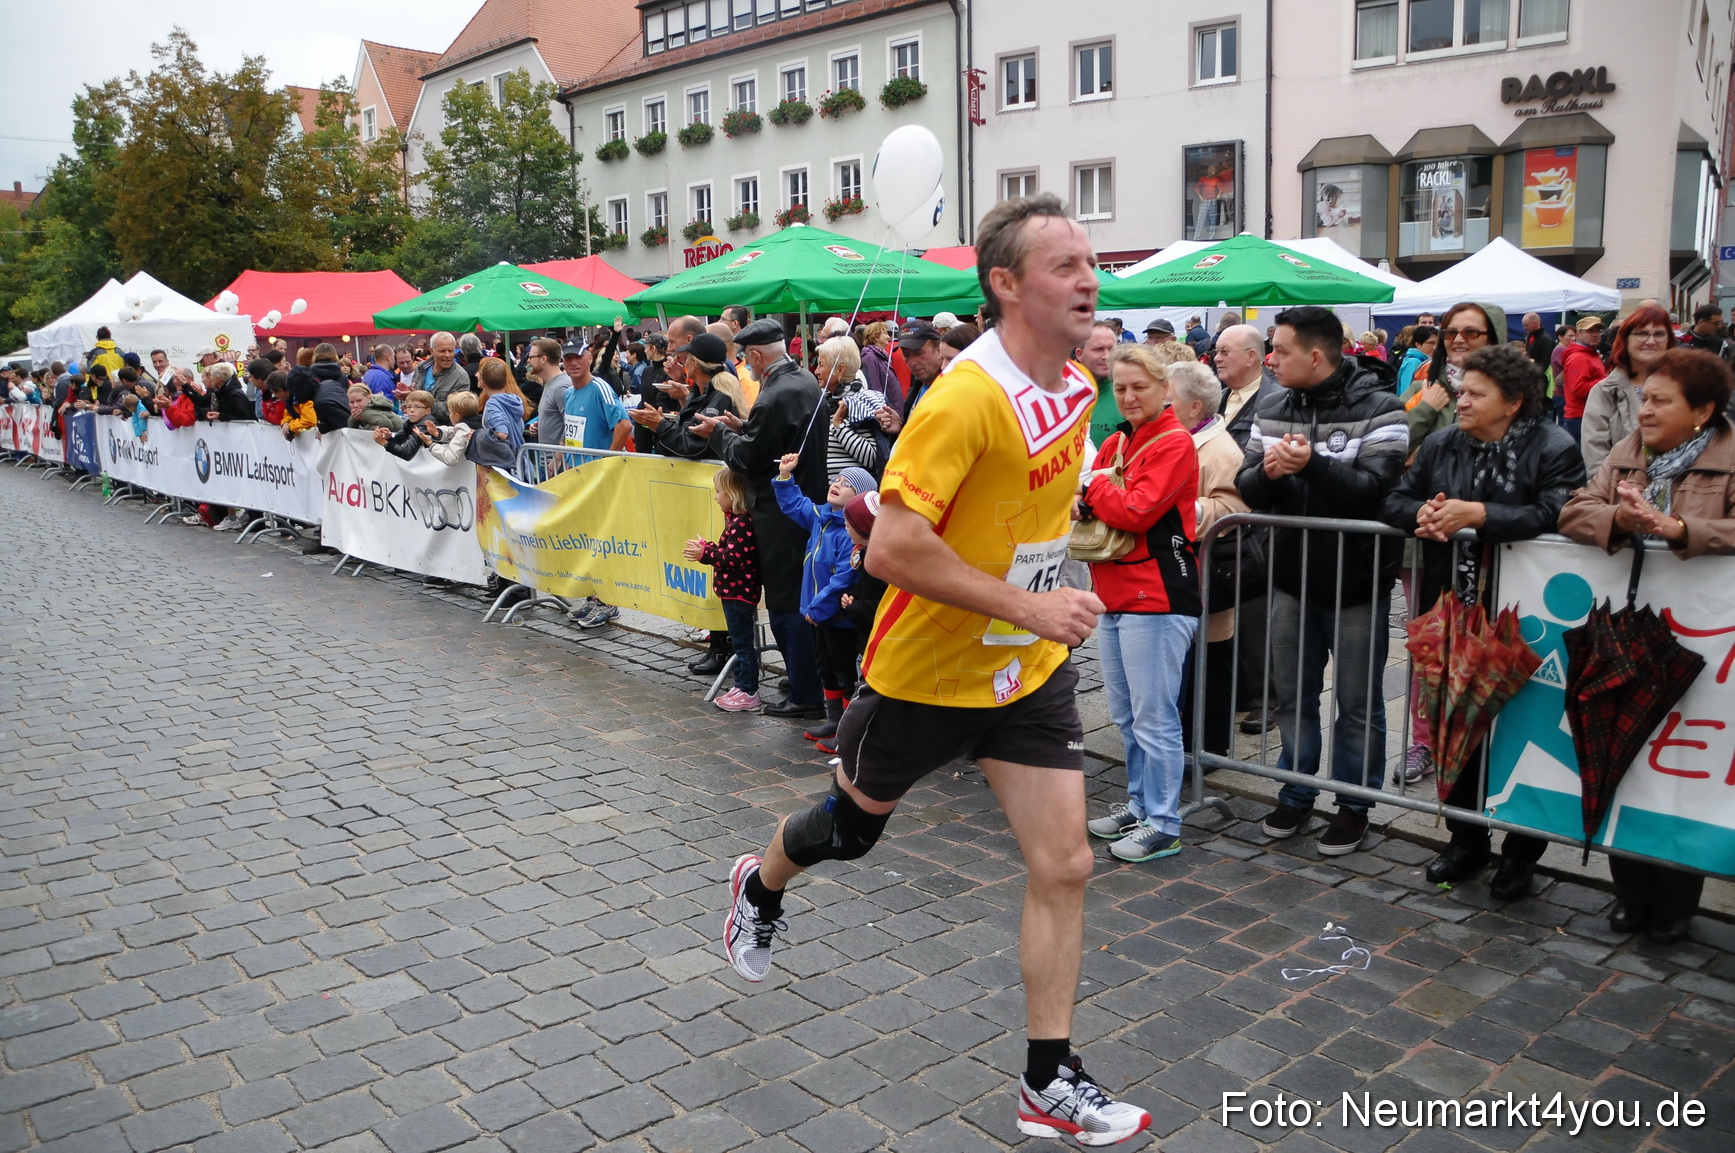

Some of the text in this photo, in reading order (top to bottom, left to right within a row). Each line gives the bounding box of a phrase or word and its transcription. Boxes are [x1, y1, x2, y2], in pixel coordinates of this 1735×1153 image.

[1501, 66, 1616, 104] RACKL
[1514, 98, 1604, 117] am Rathaus
[1420, 170, 1452, 187] RACKL
[1150, 273, 1225, 285] Lammsbräu
[518, 302, 590, 311] Lammsbräu
[214, 451, 296, 490] BMW Laufsport
[1028, 445, 1072, 492] MAX
[328, 471, 417, 521] Audi BKK
[1015, 553, 1044, 564] PARTL
[664, 561, 707, 600] KANN
